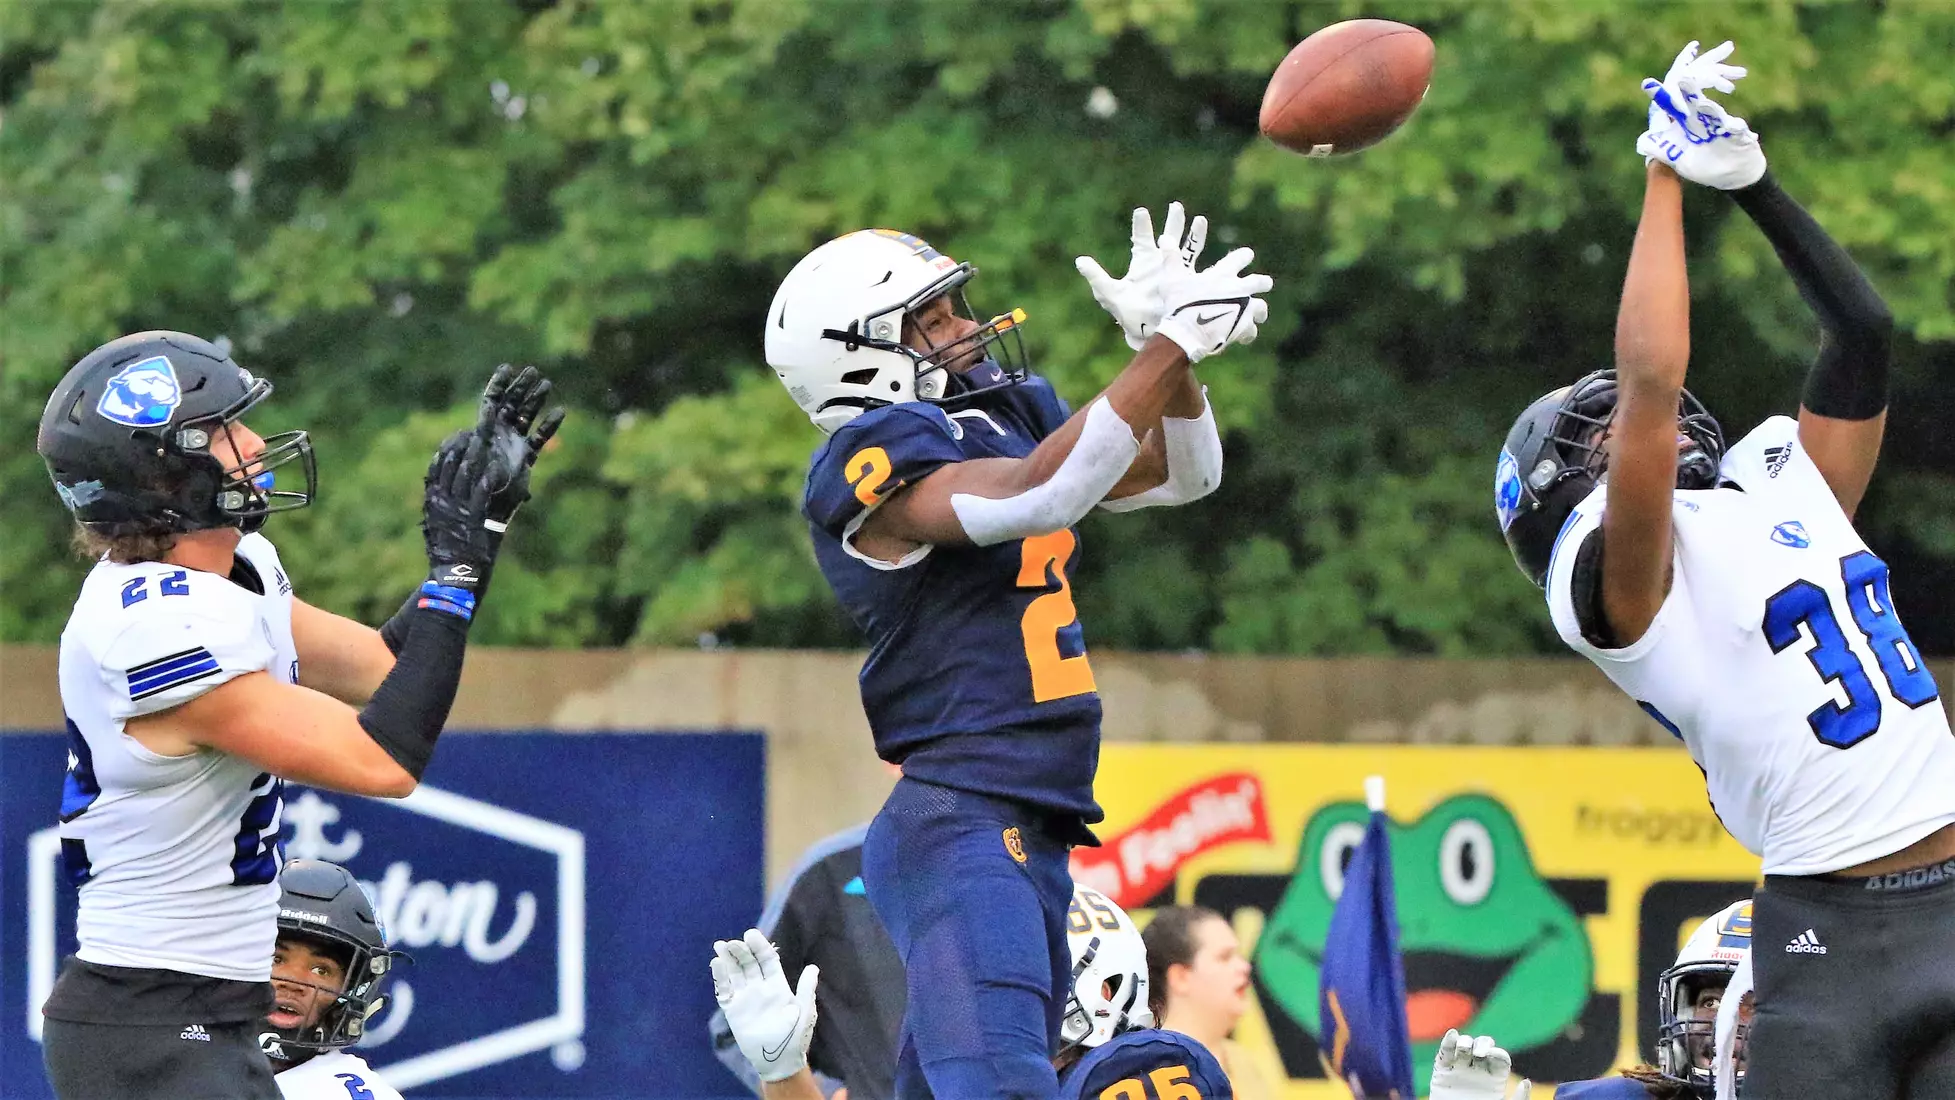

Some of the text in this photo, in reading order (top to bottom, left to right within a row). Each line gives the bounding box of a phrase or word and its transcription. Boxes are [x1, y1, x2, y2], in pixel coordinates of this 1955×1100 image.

[844, 447, 893, 506] 2
[1770, 441, 1793, 478] adidas
[121, 571, 189, 609] 22
[1016, 528, 1097, 703] 2
[1762, 550, 1938, 750] 38
[281, 909, 329, 925] Riddell
[1785, 943, 1827, 955] adidas
[180, 1031, 211, 1042] adidas
